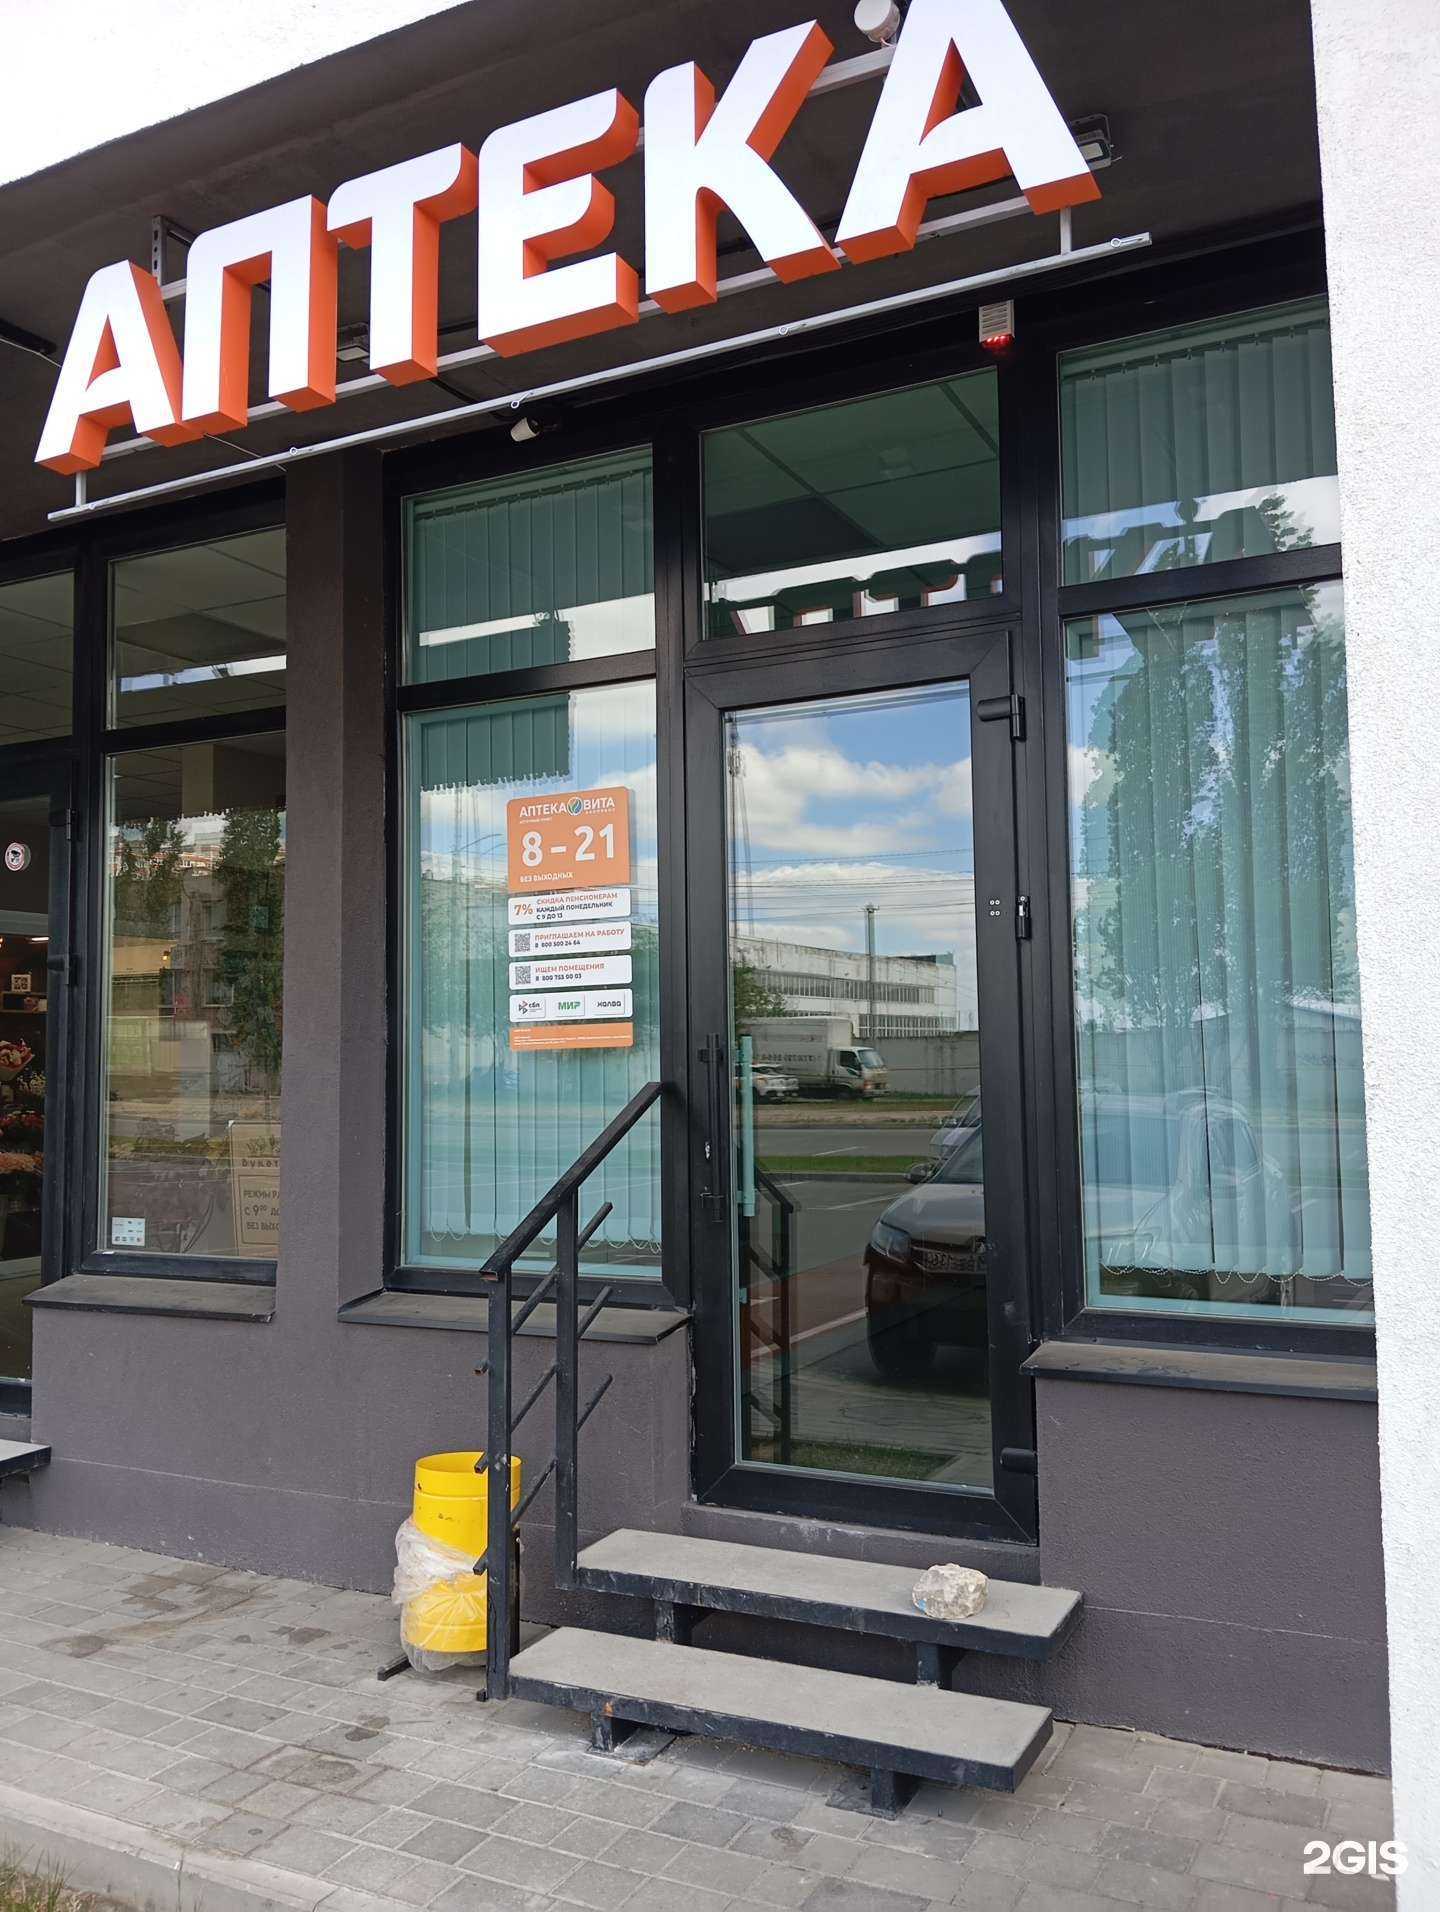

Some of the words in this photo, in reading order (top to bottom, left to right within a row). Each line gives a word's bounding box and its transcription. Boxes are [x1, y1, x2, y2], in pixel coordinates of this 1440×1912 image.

[34, 0, 1103, 475] АПТЕКА
[519, 802, 567, 817] АПТЕКА
[583, 797, 615, 810] ВИТА
[522, 831, 543, 867] 8
[574, 823, 614, 861] 21
[533, 871, 573, 882] ВЫХОДНЫХ
[536, 897, 565, 905] СКИДКА
[565, 892, 618, 903] ПЕНСИОНЕРАМ
[514, 903, 533, 916] 7%
[536, 903, 565, 913] КАЖДЫЙ
[566, 901, 613, 911] ПОНЕДЕЛЬНИК
[535, 932, 584, 941] ПРИГЛАШАЕМ
[597, 928, 625, 937] РАБОТУ
[535, 965, 558, 973] ИЩЕМ
[558, 1001, 582, 1011] МИР
